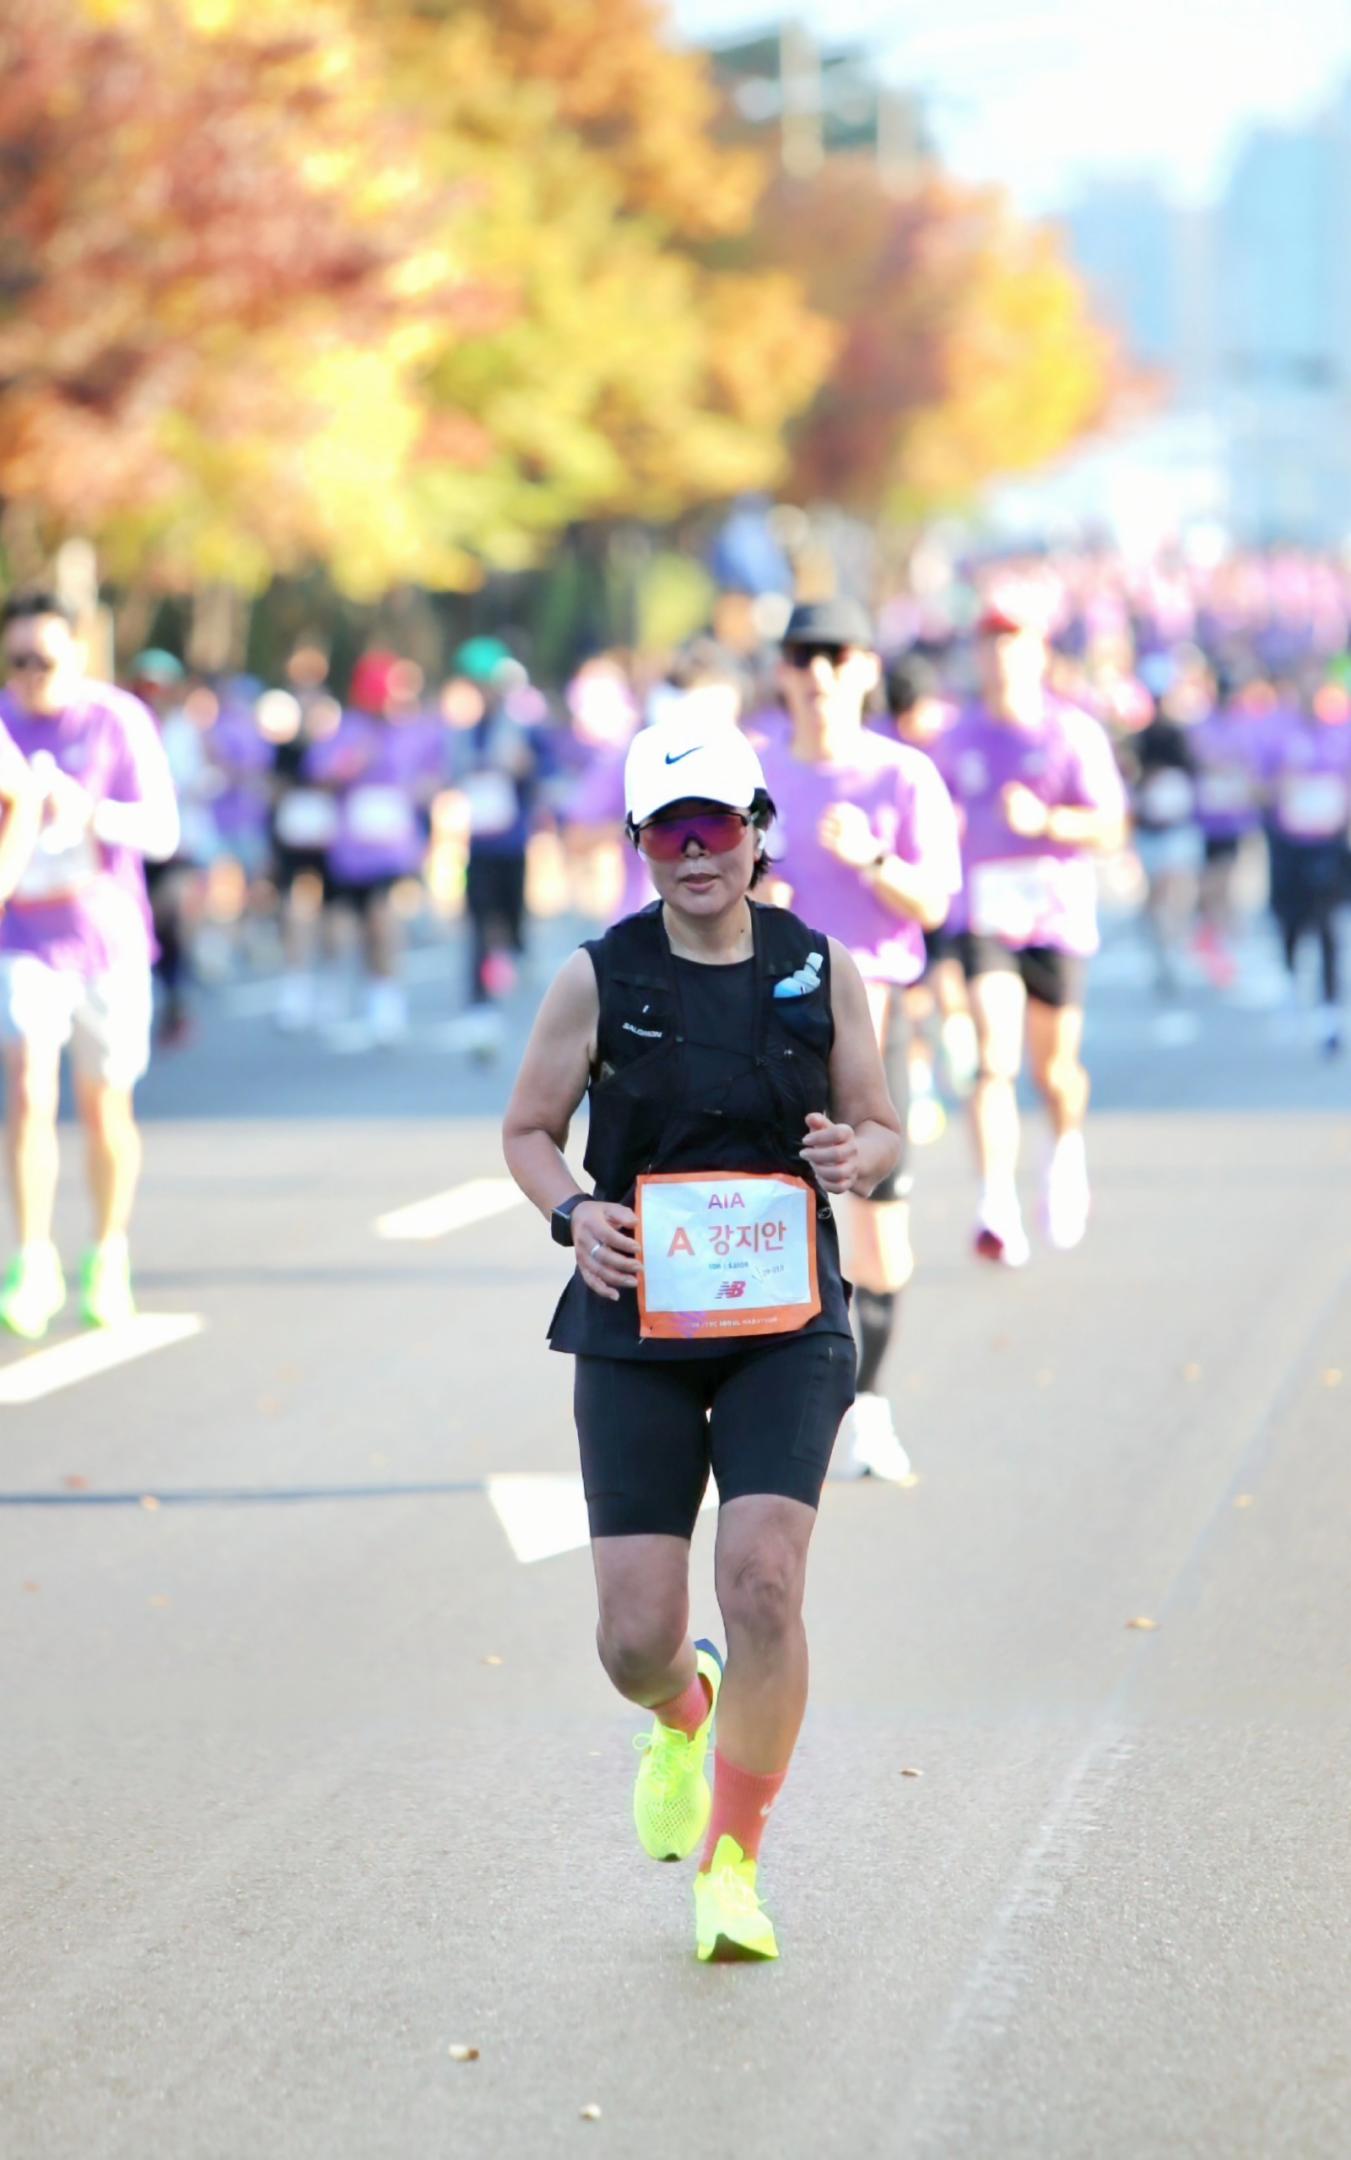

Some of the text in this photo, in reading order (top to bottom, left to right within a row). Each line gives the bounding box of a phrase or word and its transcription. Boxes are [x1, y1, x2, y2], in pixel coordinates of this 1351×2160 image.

[622, 1022, 662, 1038] SALOMON
[708, 1192, 745, 1209] AIA
[667, 1220, 787, 1257] A 강지안
